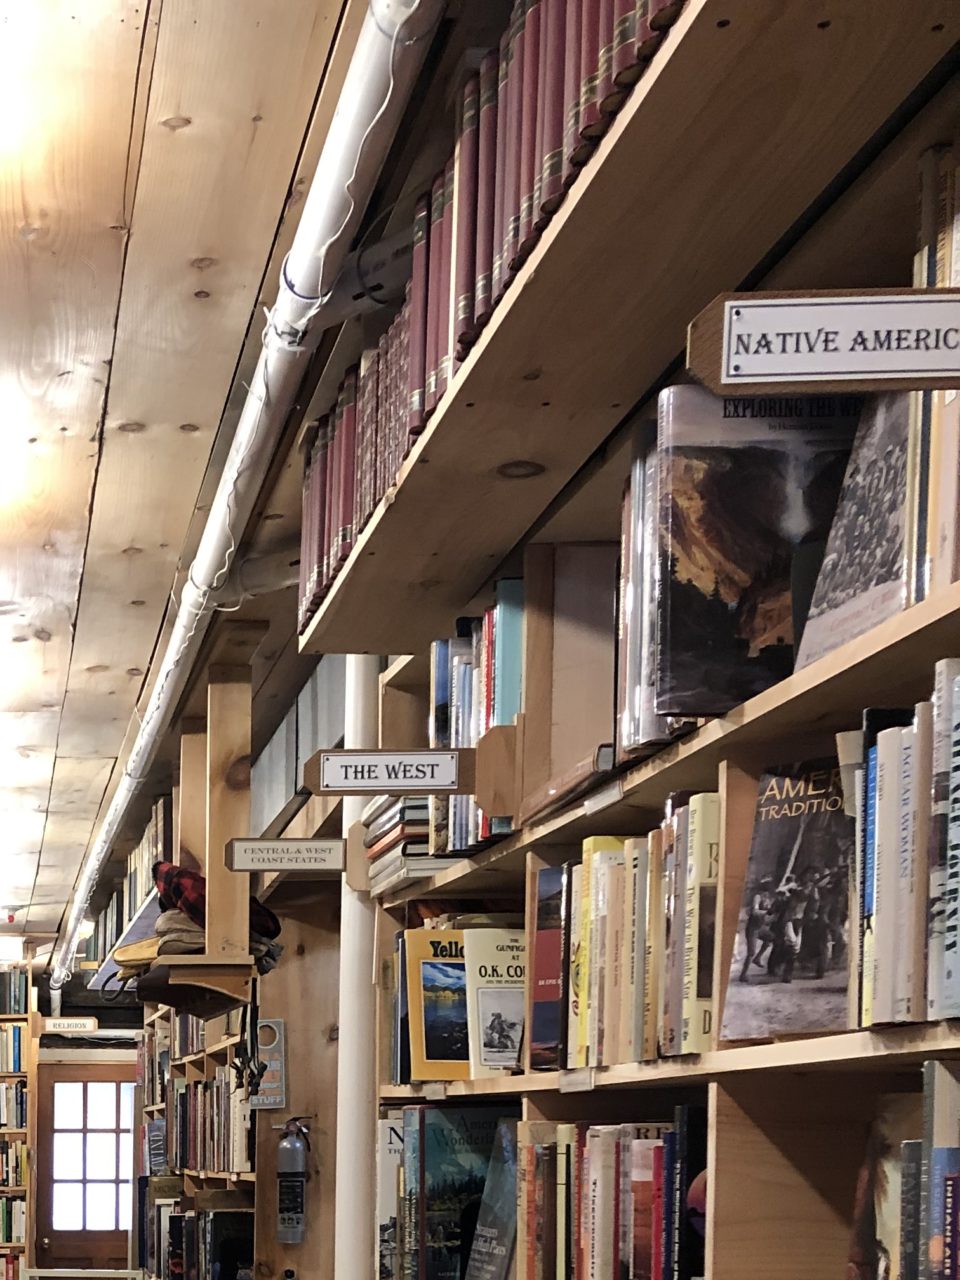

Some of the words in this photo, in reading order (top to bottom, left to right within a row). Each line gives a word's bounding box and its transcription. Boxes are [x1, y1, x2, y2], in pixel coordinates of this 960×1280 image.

[733, 328, 840, 356] NATIVE
[341, 763, 378, 780] THE
[384, 761, 439, 779] WEST
[901, 745, 912, 807] JAGUAR
[899, 811, 910, 878] WOMAN
[479, 965, 503, 978] O.K.
[685, 947, 694, 978] Bright
[684, 979, 692, 1001] Star
[53, 1022, 87, 1030] RELIGION
[251, 1096, 281, 1104] STUFF
[150, 1130, 164, 1167] WIND
[945, 1179, 953, 1244] INDIANS
